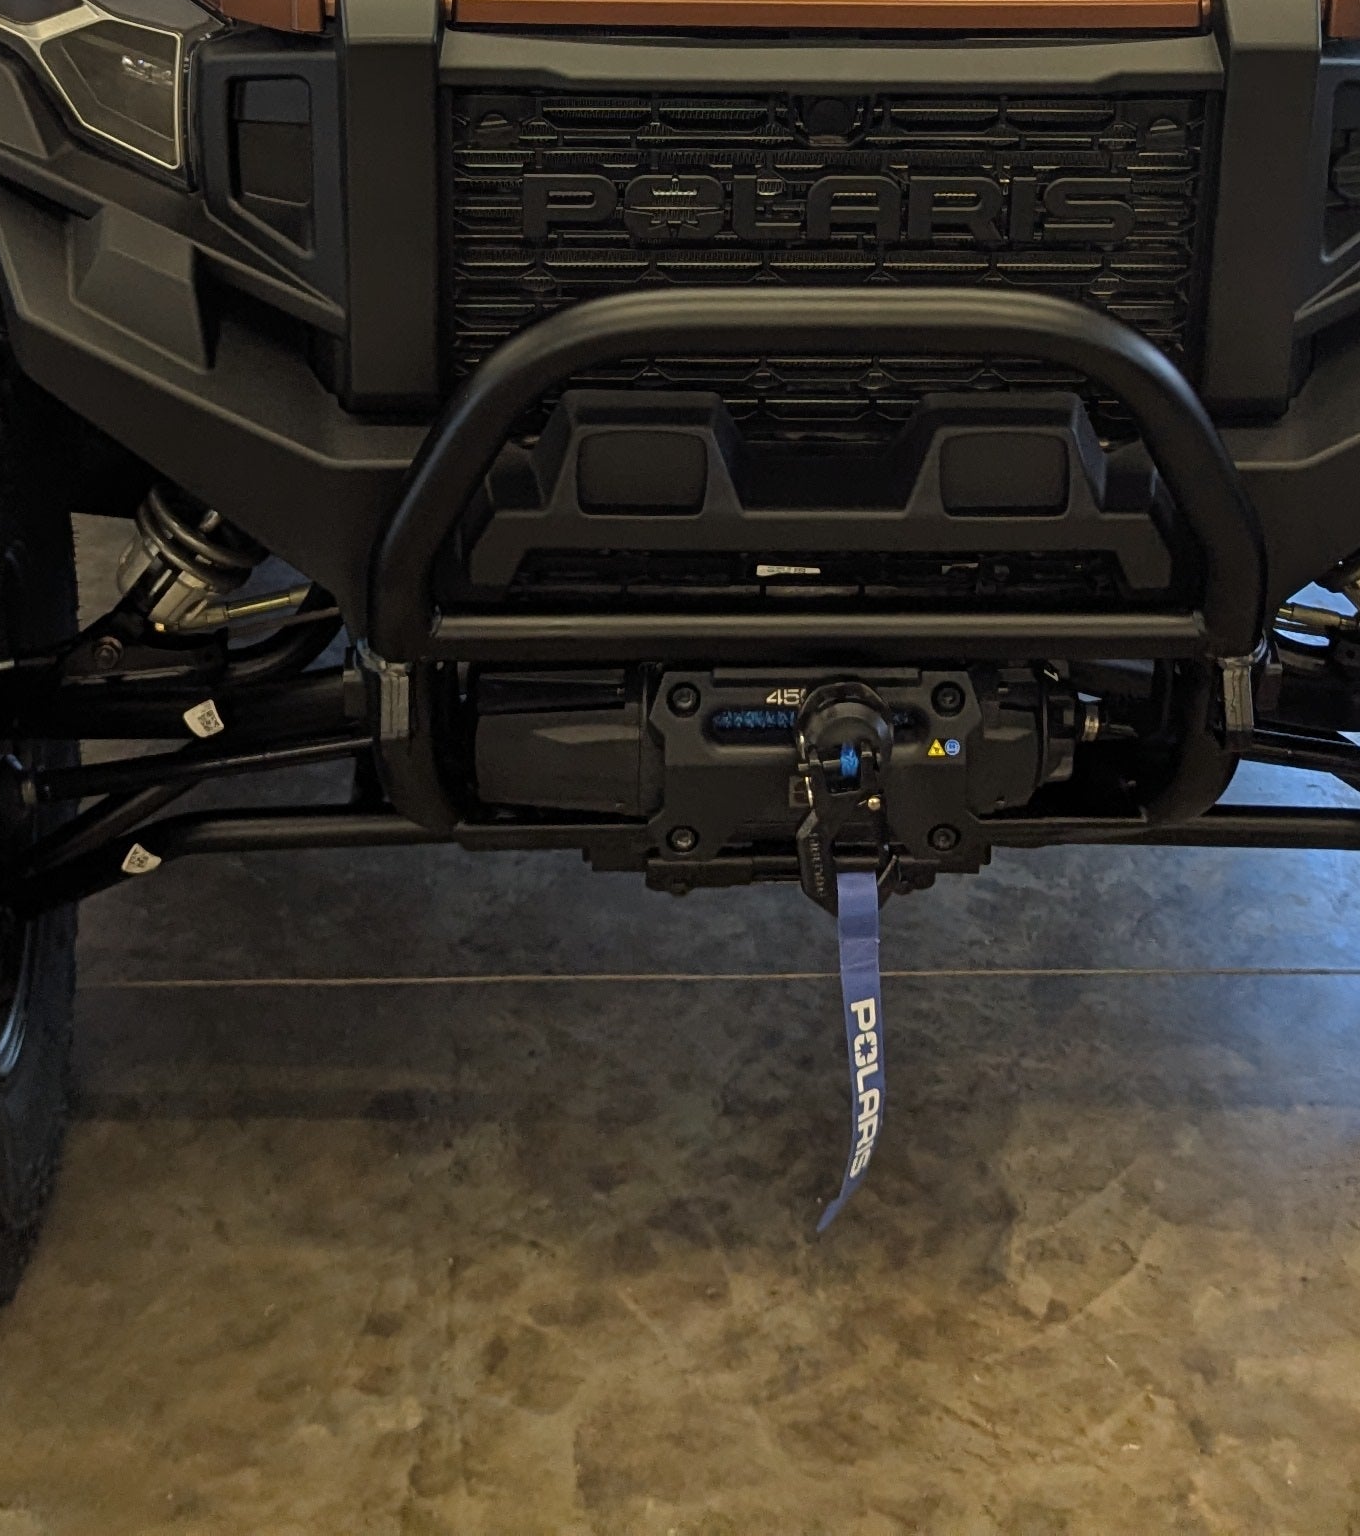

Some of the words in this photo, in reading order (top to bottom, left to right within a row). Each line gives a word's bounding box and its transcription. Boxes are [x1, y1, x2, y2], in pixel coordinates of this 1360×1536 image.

[522, 173, 1137, 243] POLARIS
[766, 688, 807, 706] 45
[850, 997, 881, 1178] POLARIS
